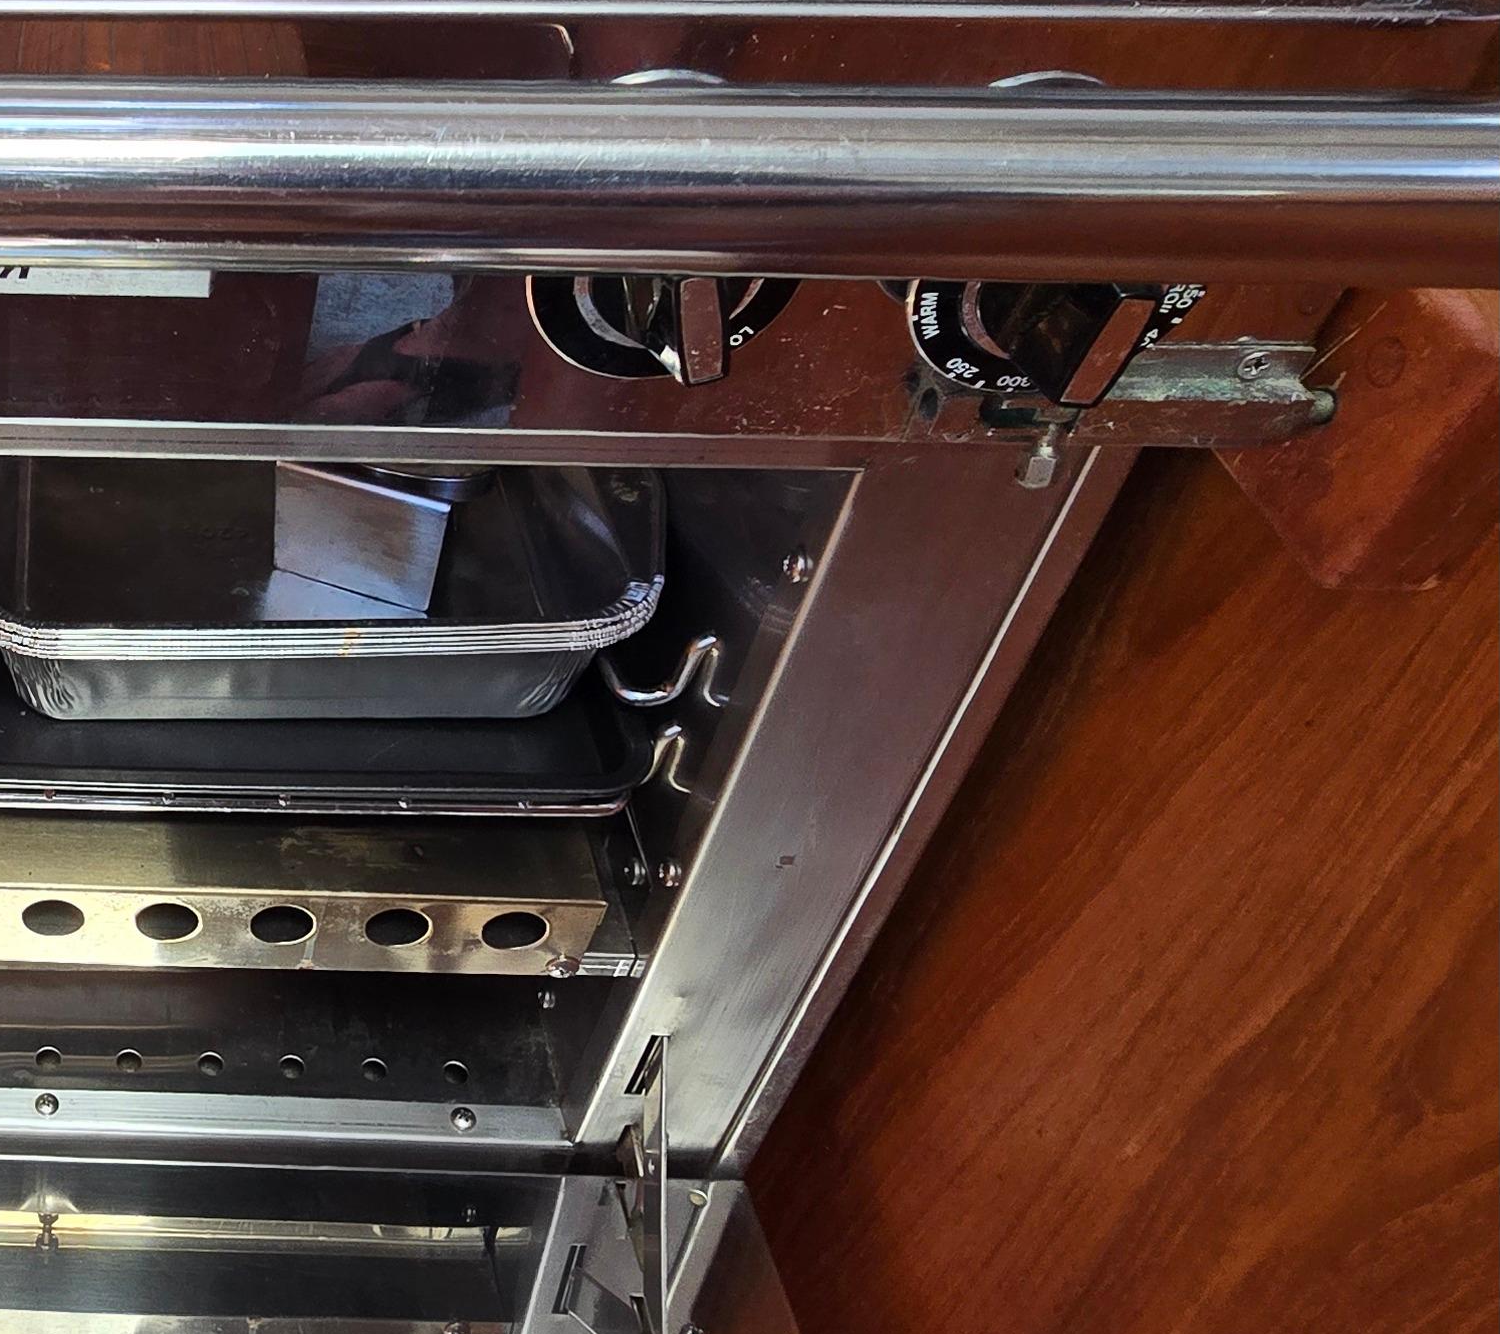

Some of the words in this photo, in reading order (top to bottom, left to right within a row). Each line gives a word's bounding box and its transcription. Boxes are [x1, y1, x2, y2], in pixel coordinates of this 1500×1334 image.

[920, 291, 940, 340] WARM
[729, 325, 754, 347] LO
[946, 357, 981, 378] 250
[996, 374, 1032, 388] 300
